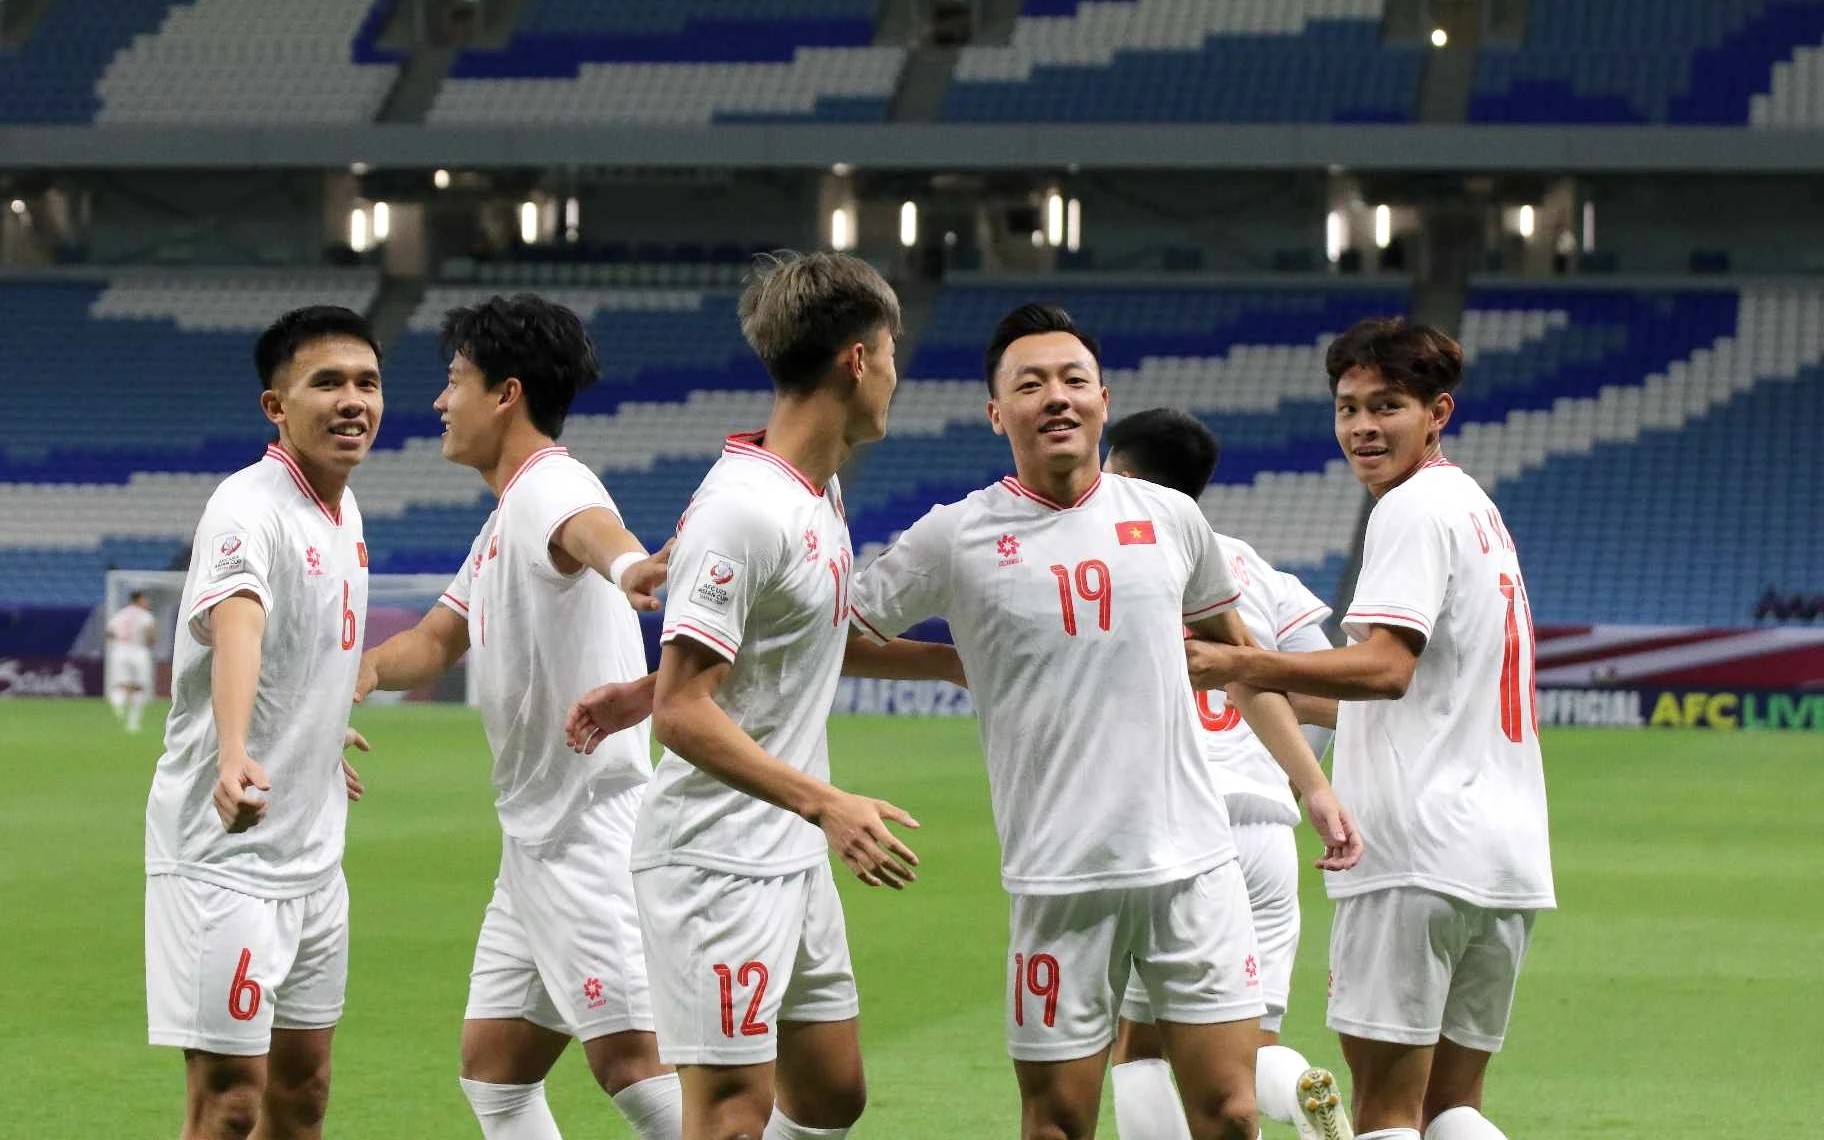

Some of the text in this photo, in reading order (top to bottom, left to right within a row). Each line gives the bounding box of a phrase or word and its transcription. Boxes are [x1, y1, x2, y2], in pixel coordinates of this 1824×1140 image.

[341, 580, 356, 651] 6
[1050, 558, 1113, 637] 19
[1650, 692, 1739, 728] AFC
[228, 948, 262, 1022] 6
[713, 960, 769, 1038] 12
[1014, 953, 1061, 1027] 19
